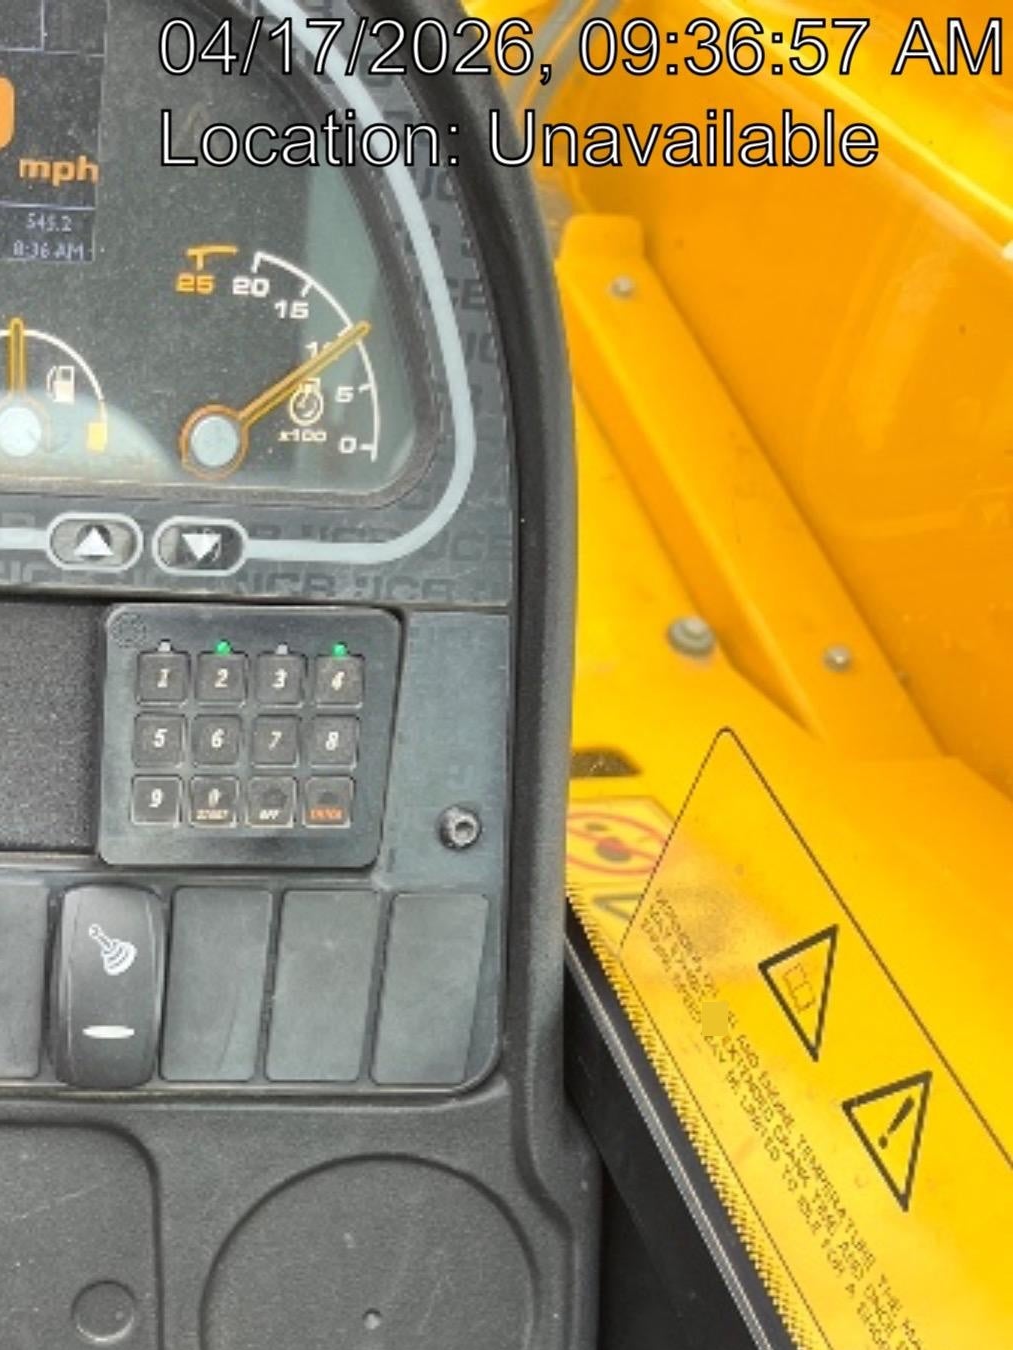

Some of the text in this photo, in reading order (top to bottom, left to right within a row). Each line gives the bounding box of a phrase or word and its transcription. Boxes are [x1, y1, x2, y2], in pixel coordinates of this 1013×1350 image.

[18, 155, 100, 187] mph
[175, 272, 216, 295] 25
[231, 276, 270, 298] 20
[274, 299, 310, 320] 15
[335, 385, 355, 404] 5
[339, 436, 358, 455] 0
[157, 668, 170, 688] 1
[214, 668, 229, 688] 2
[272, 668, 287, 689] 3
[153, 728, 339, 750] 5 6 7 8
[148, 788, 163, 808] 9
